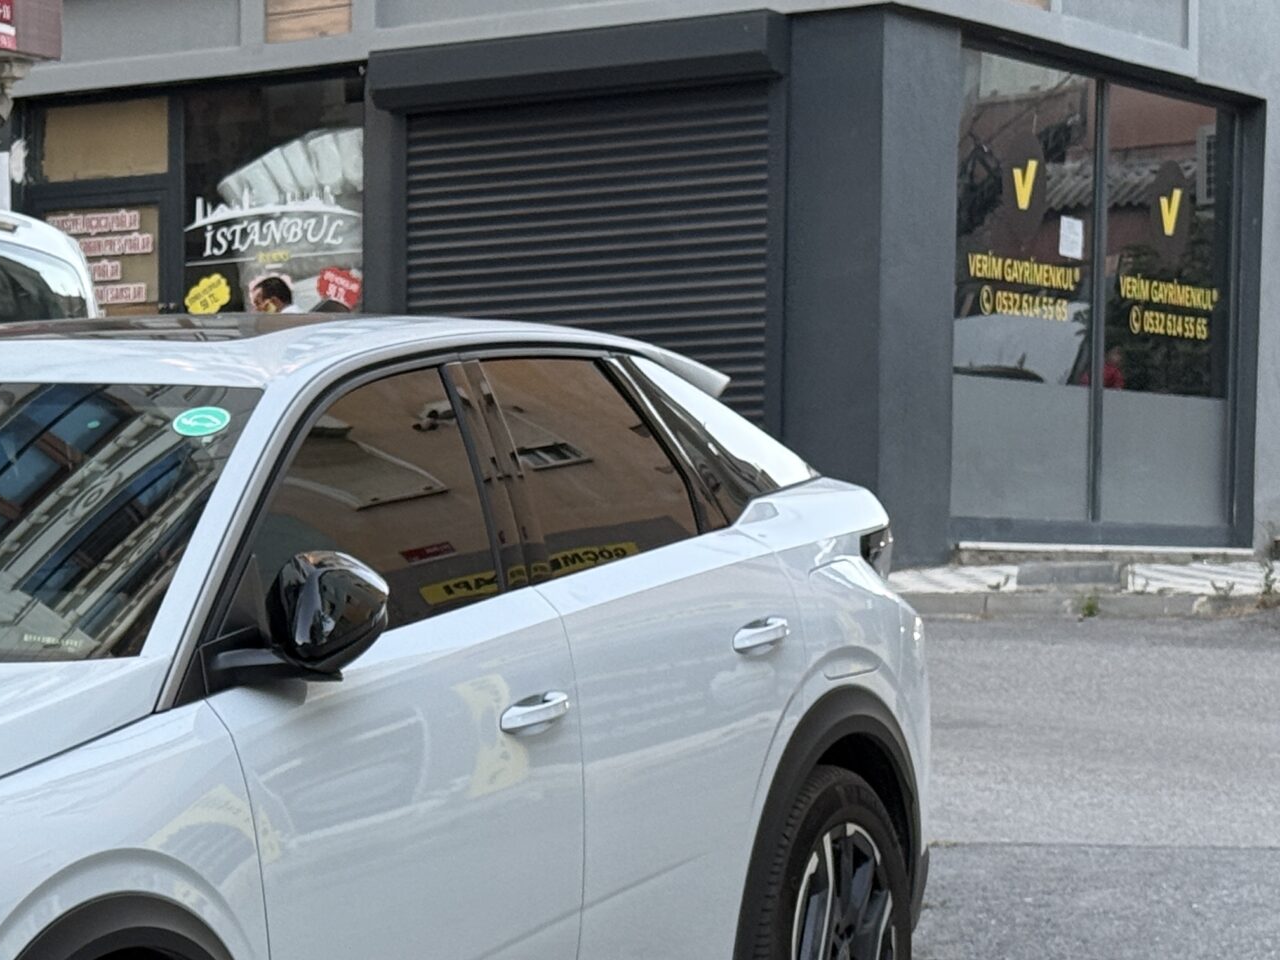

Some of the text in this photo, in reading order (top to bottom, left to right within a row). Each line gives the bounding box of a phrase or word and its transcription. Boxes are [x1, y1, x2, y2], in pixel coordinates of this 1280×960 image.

[203, 215, 344, 257] İSTANBUL
[968, 250, 1002, 280] VERİM
[1120, 273, 1150, 300] VERİM
